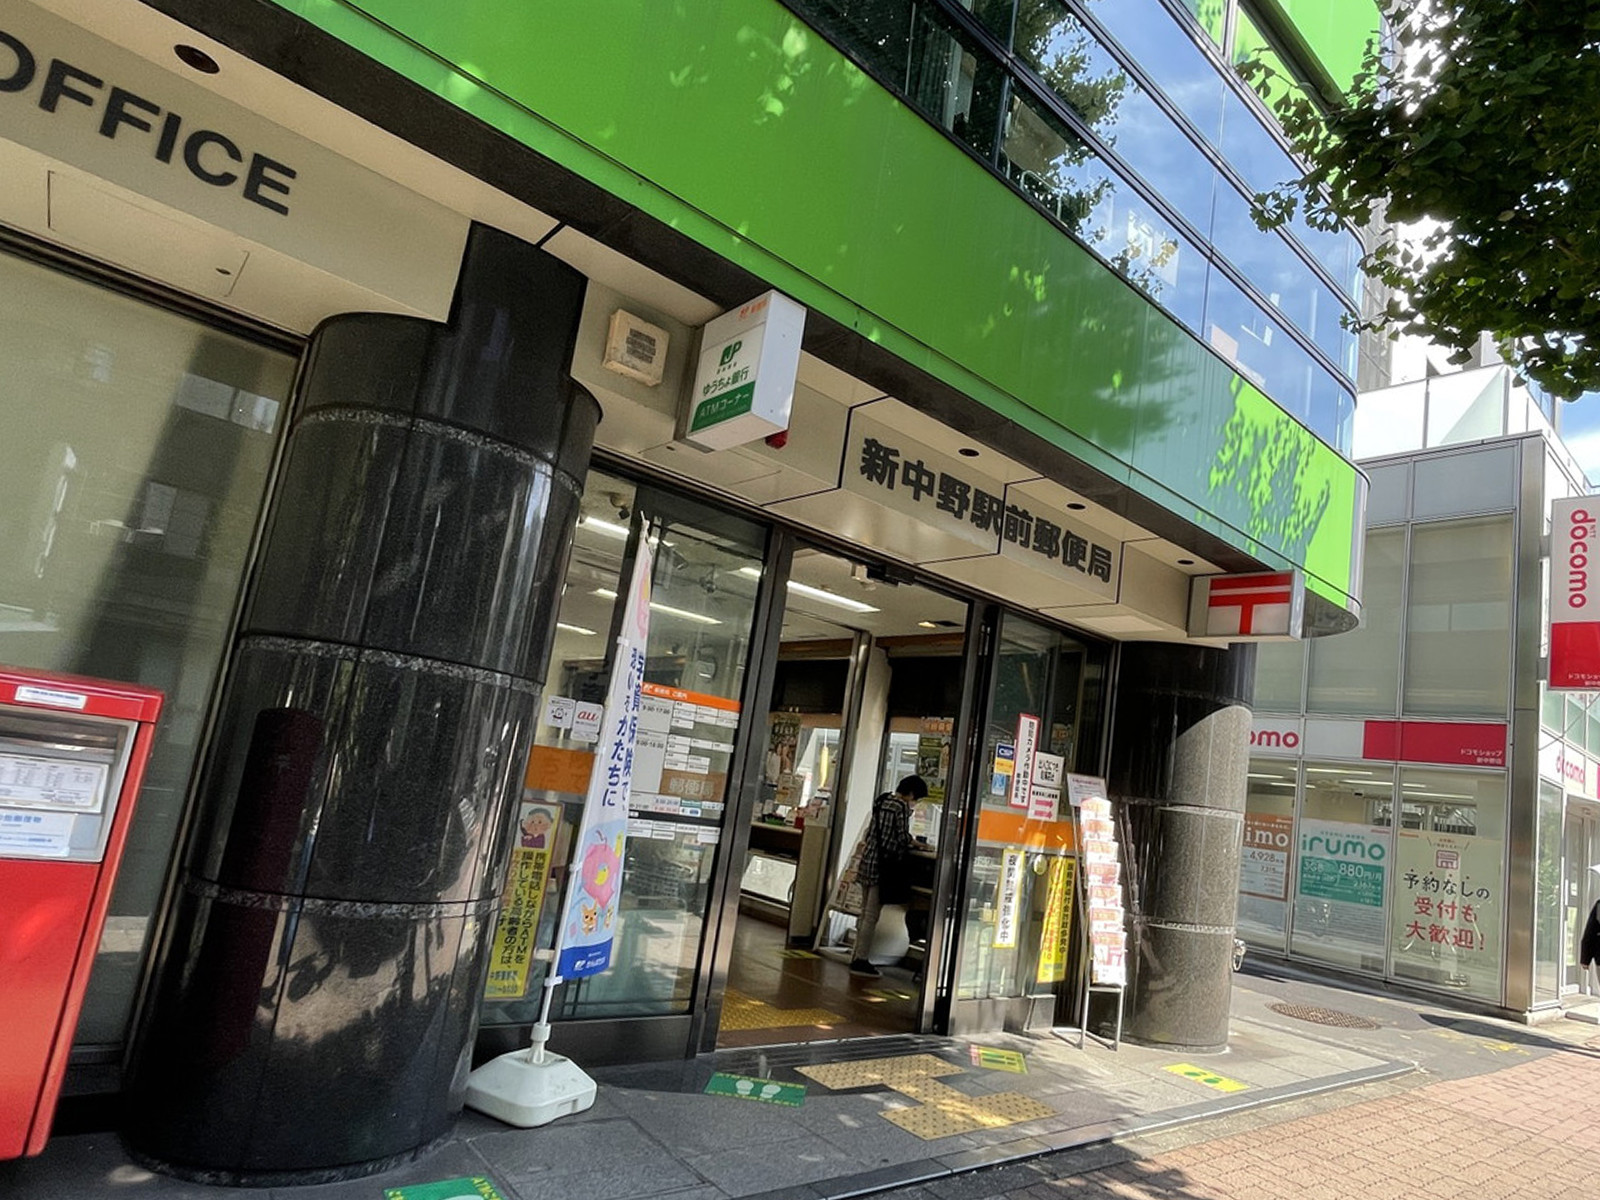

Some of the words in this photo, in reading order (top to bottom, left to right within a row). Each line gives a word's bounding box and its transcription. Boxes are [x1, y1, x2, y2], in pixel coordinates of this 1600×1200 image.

[702, 365, 750, 397] ゆうちょ銀行
[700, 392, 750, 418] ATMコーナー
[860, 437, 1113, 584] 新中野駅前郵便局
[1568, 509, 1597, 608] docomo
[577, 710, 599, 722] au
[1302, 833, 1386, 861] irumo
[1403, 872, 1490, 900] 予約なしの
[1413, 896, 1478, 923] 受付も
